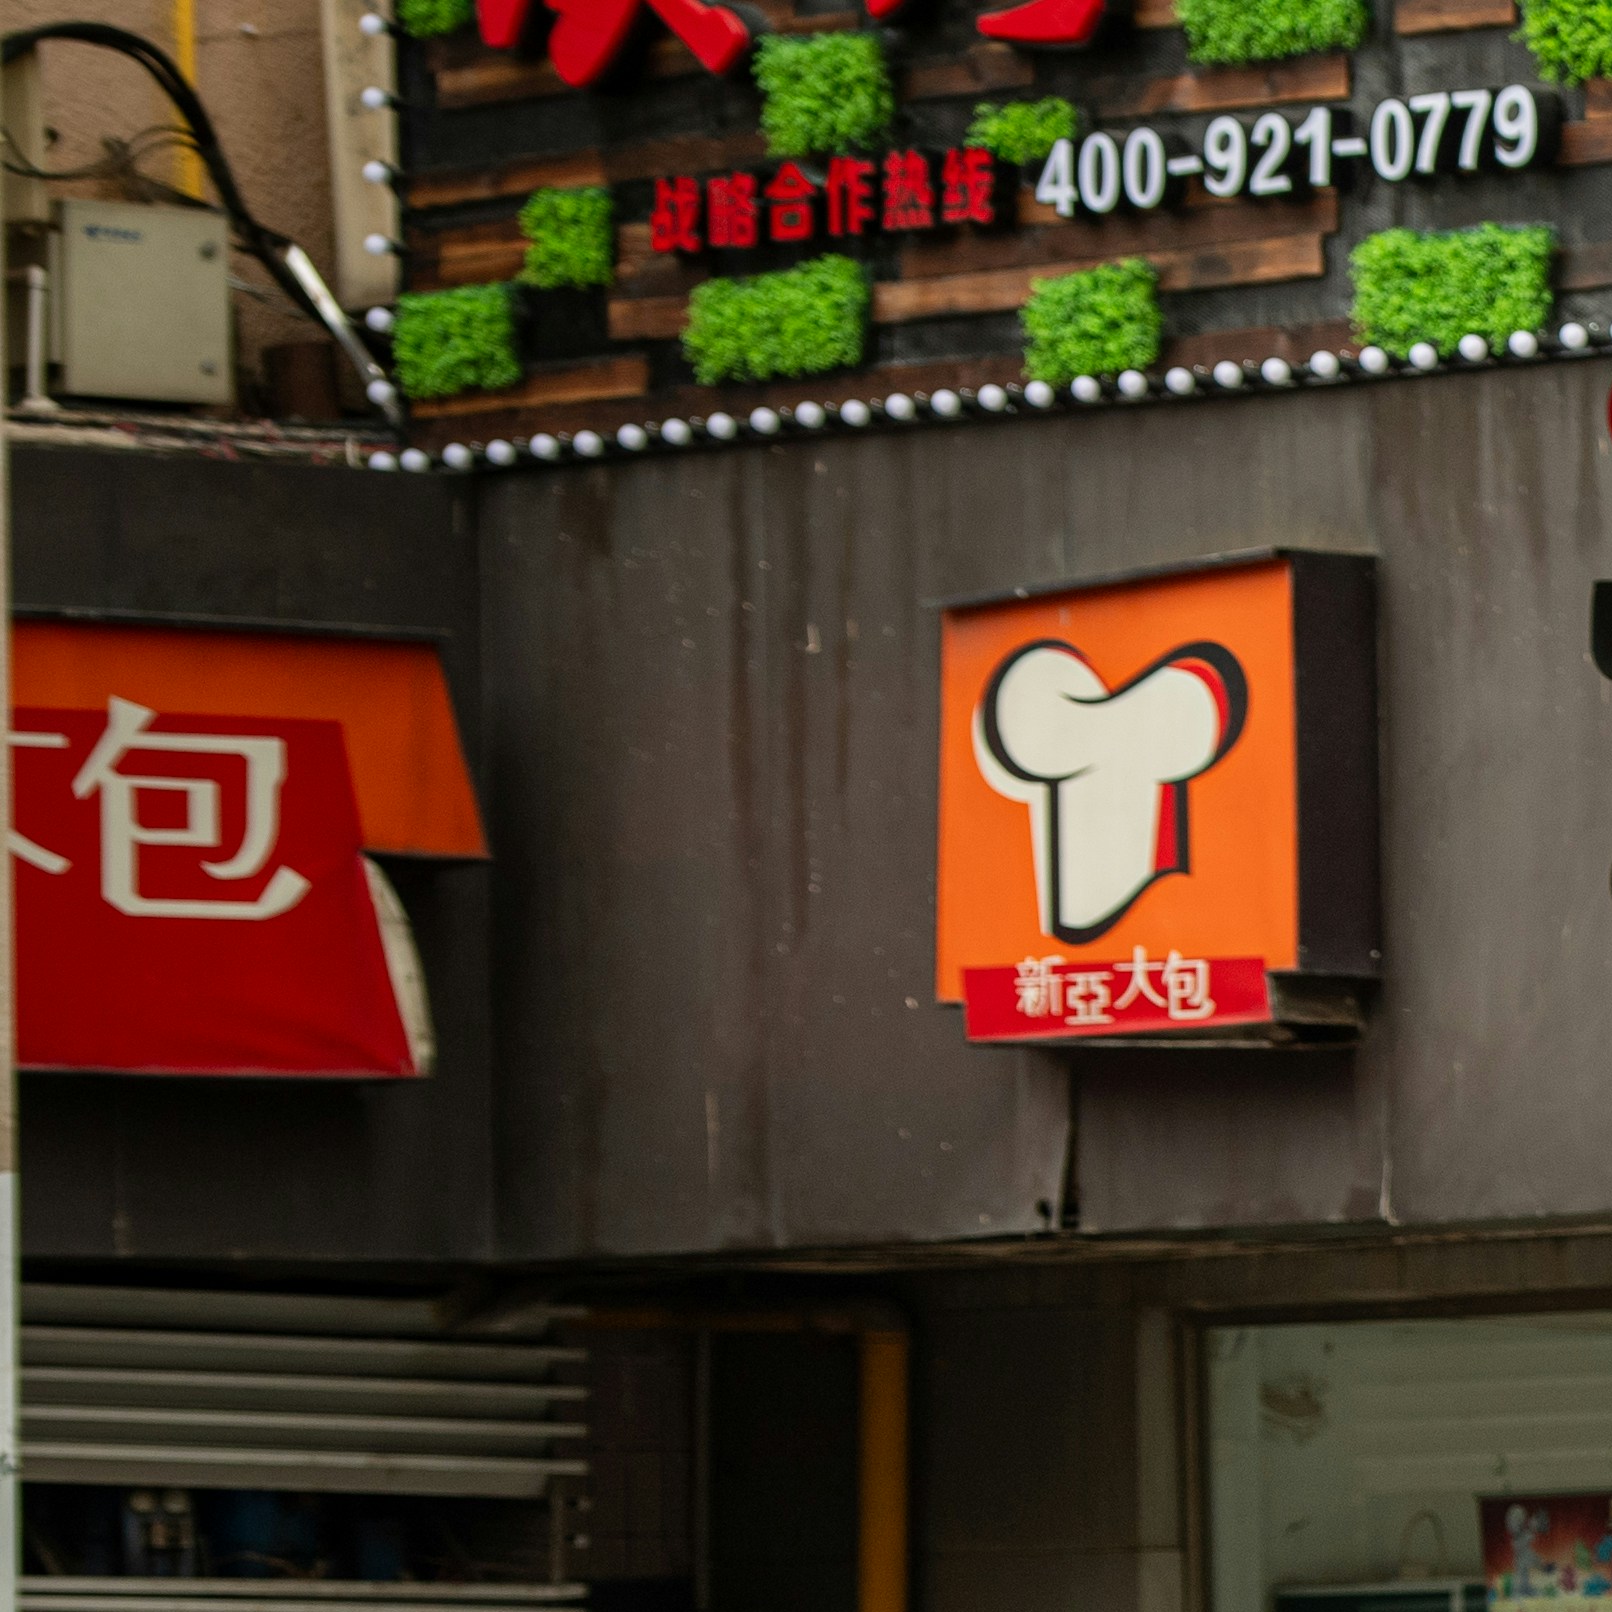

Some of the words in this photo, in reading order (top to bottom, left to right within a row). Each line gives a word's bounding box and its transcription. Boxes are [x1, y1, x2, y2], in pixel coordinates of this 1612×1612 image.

[649, 148, 995, 253] 战略合作热线
[1035, 84, 1538, 217] 400-921-0779
[1015, 945, 1216, 1026] 新亞大包
